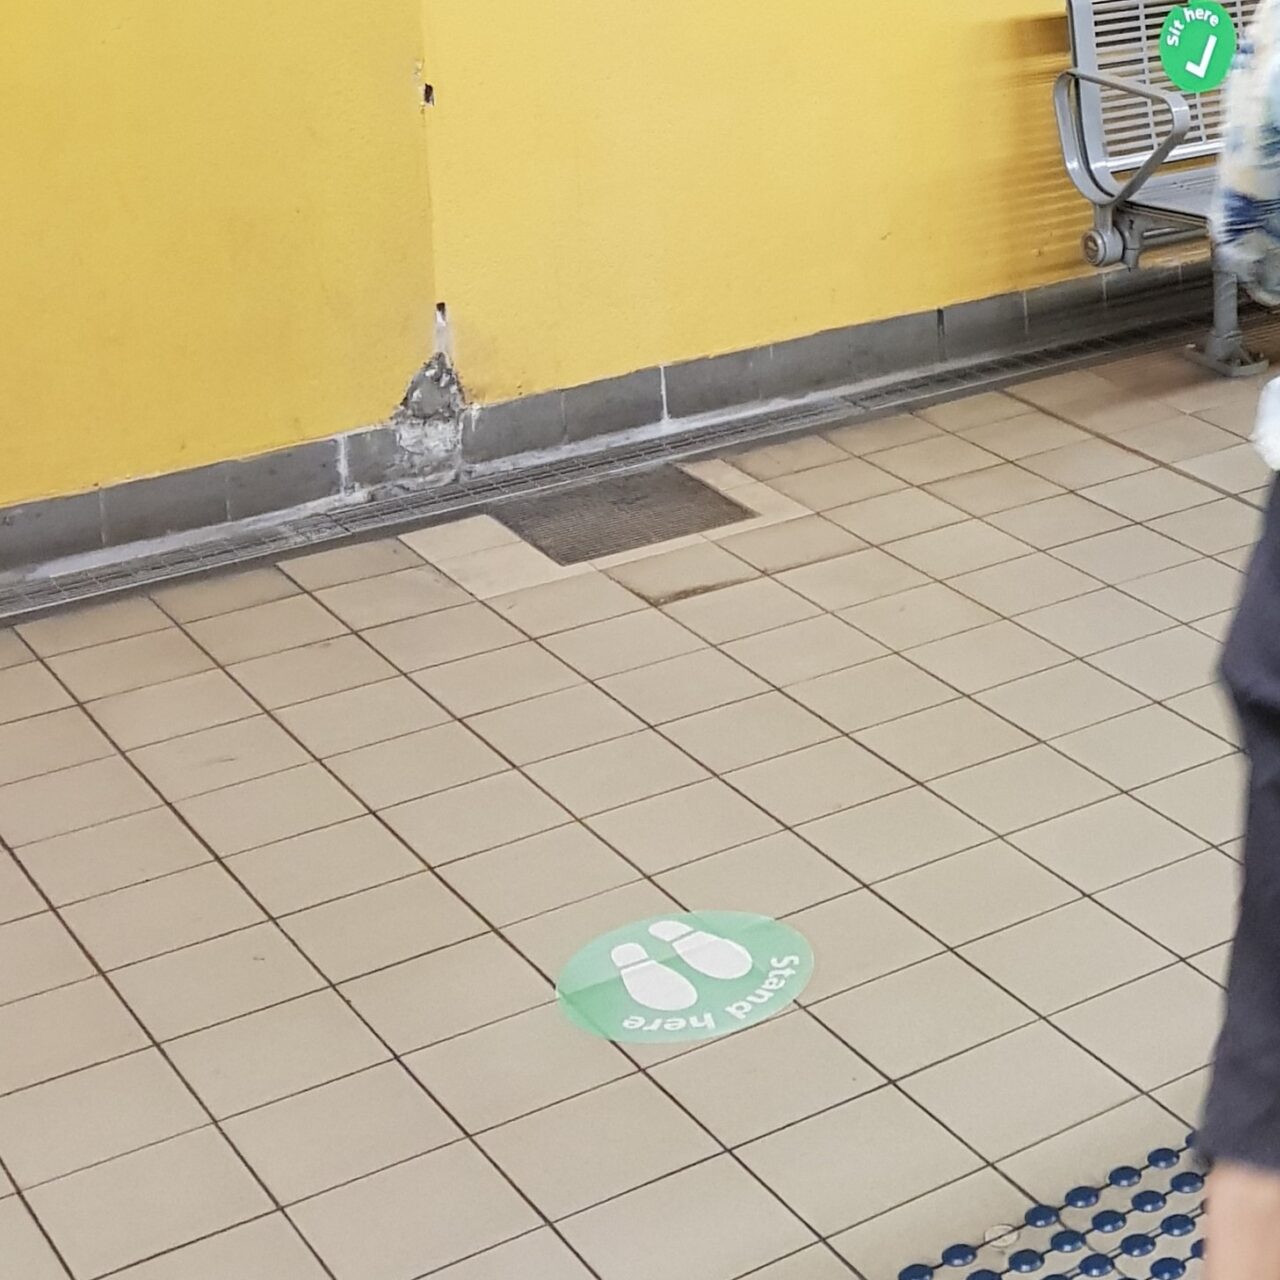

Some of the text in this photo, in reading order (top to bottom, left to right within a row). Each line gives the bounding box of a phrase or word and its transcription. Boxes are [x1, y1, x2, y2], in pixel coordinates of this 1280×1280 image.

[1166, 7, 1220, 47] Sit here
[622, 954, 799, 1031] Stand here
